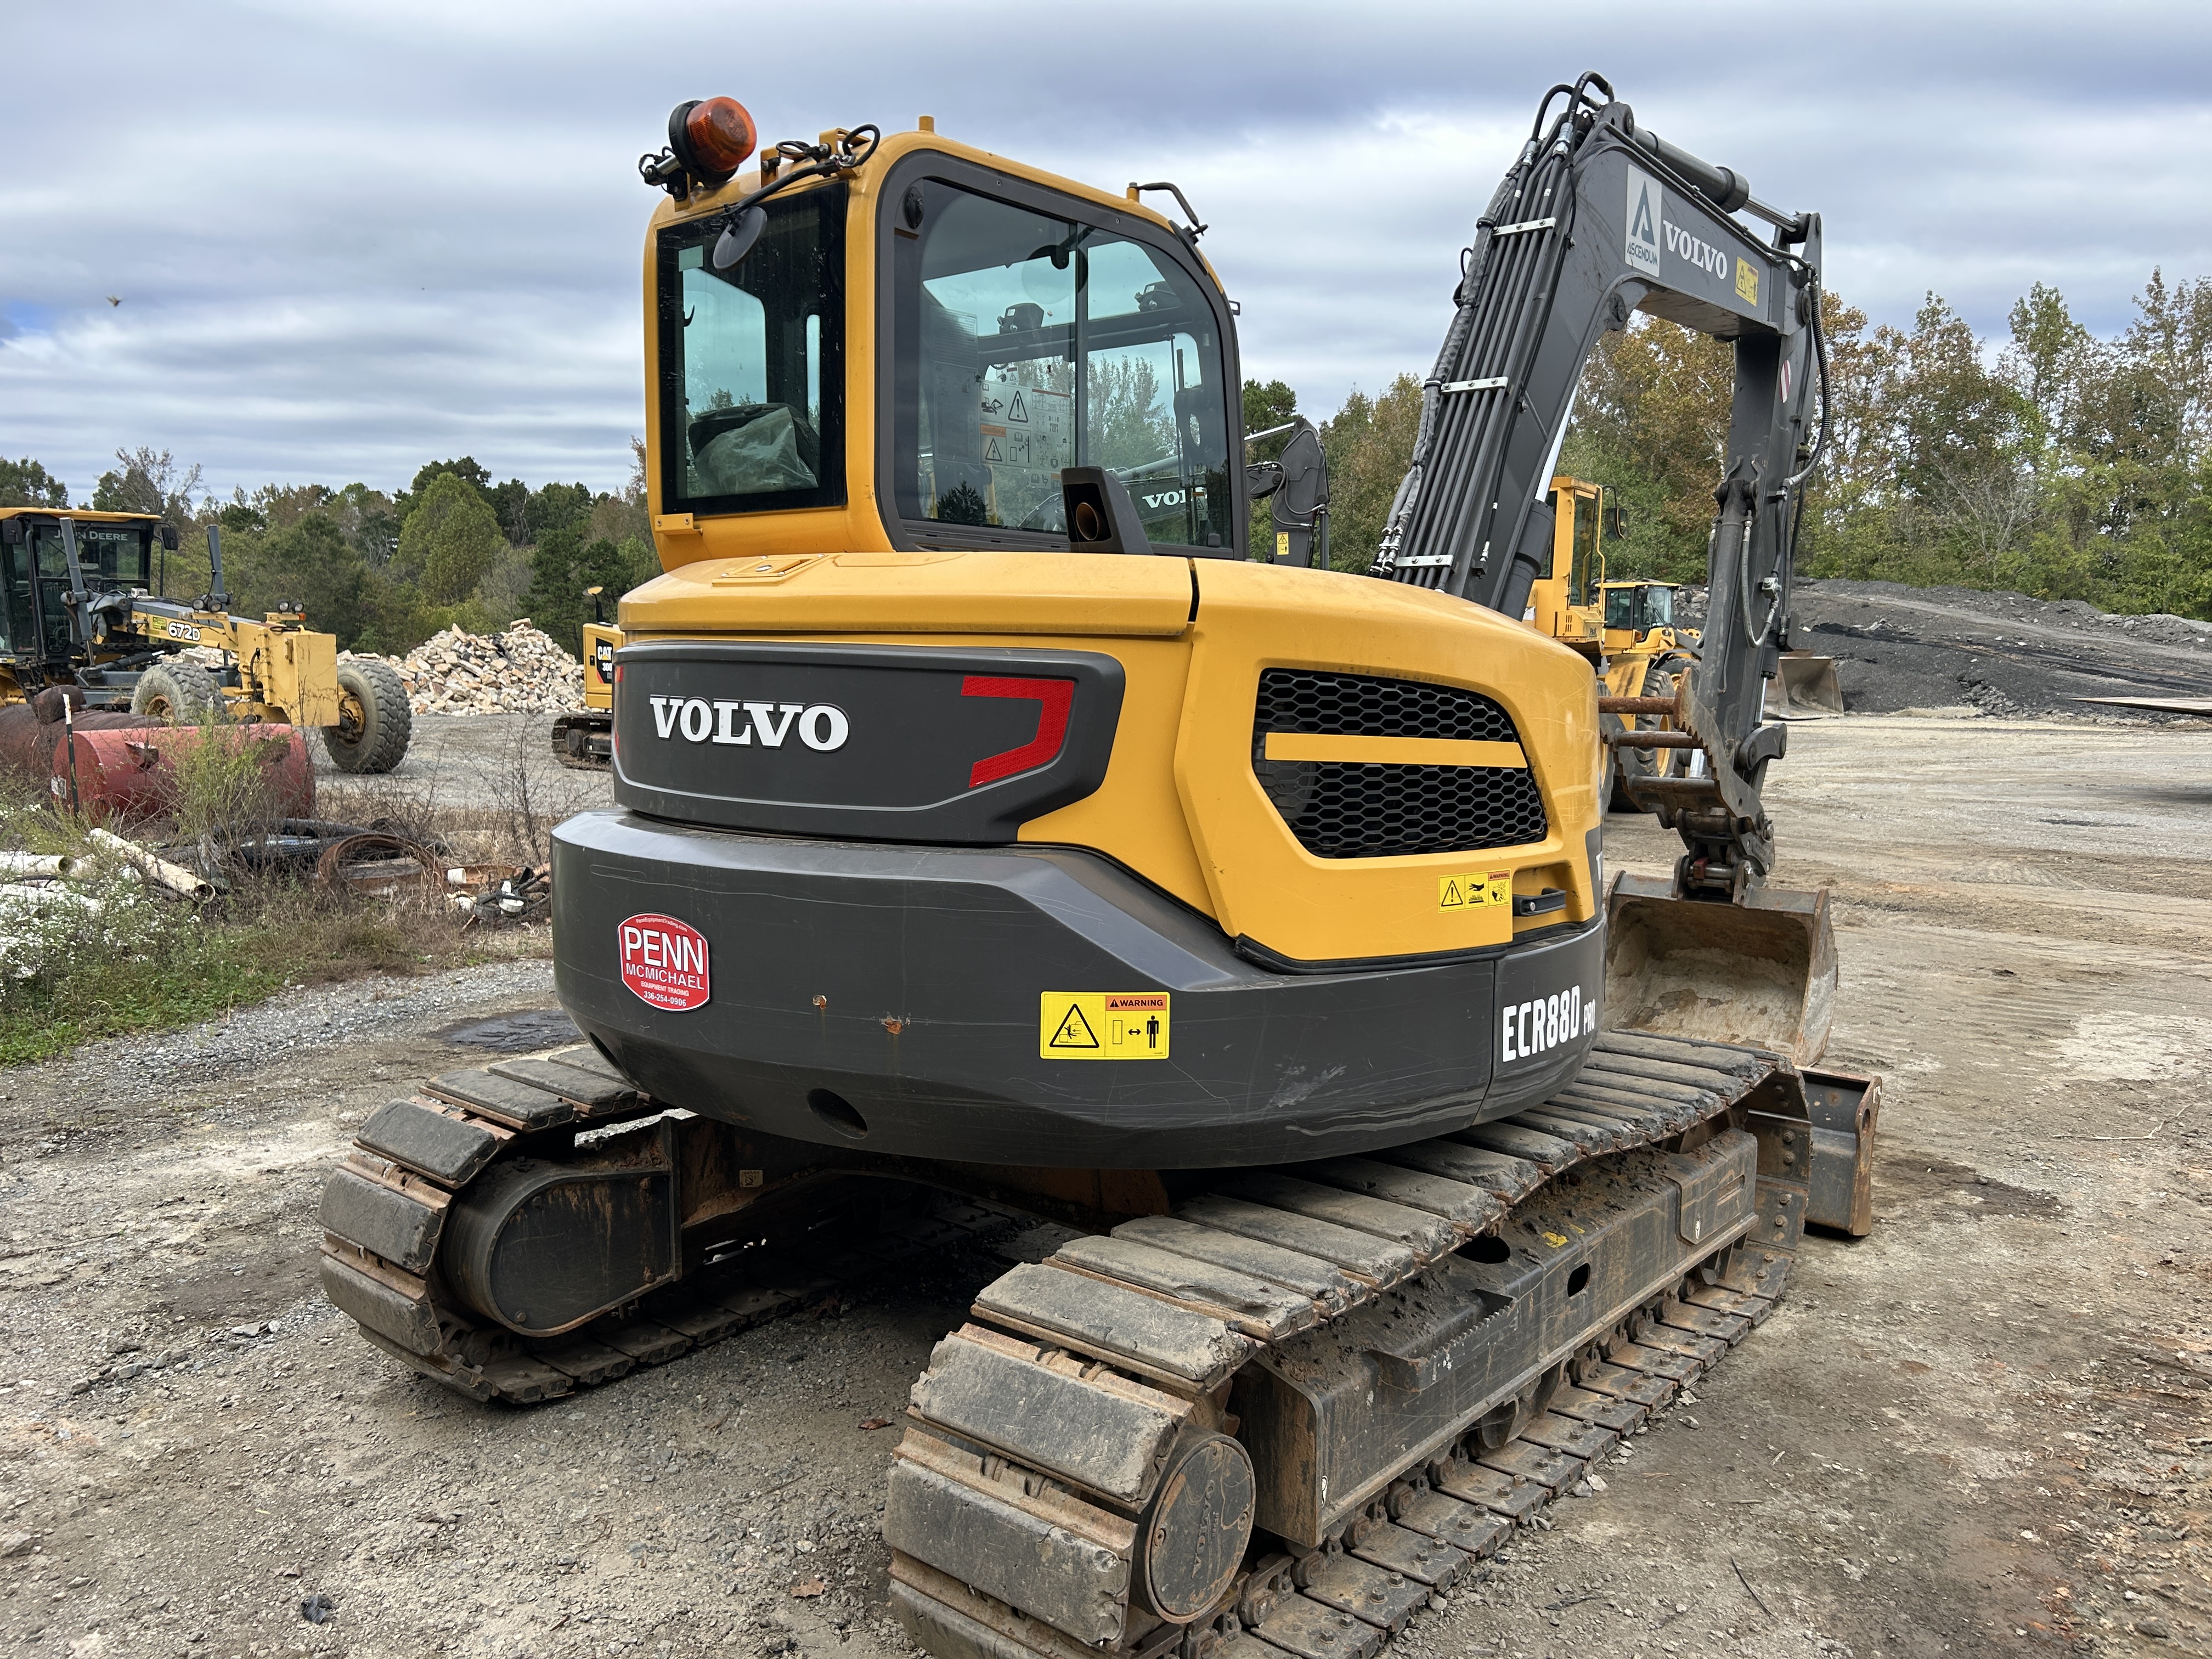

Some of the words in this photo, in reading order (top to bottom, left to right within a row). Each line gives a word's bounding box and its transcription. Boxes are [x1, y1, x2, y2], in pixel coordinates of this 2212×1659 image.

[1627, 241, 1658, 267] ASCENDUM
[1663, 219, 1728, 280] VOLVO
[89, 531, 128, 541] DEERE
[168, 621, 201, 641] 672D
[597, 646, 612, 661] CAT
[650, 697, 849, 751] VOLVO
[624, 926, 704, 975] PENN
[625, 962, 705, 990] MCMICHAEL
[641, 980, 667, 992] EQUIPMENT
[667, 986, 690, 997] TRADING
[644, 990, 687, 1007] 336-254-0906
[1502, 985, 1580, 1063] ECR88D
[1583, 998, 1595, 1036] PRO
